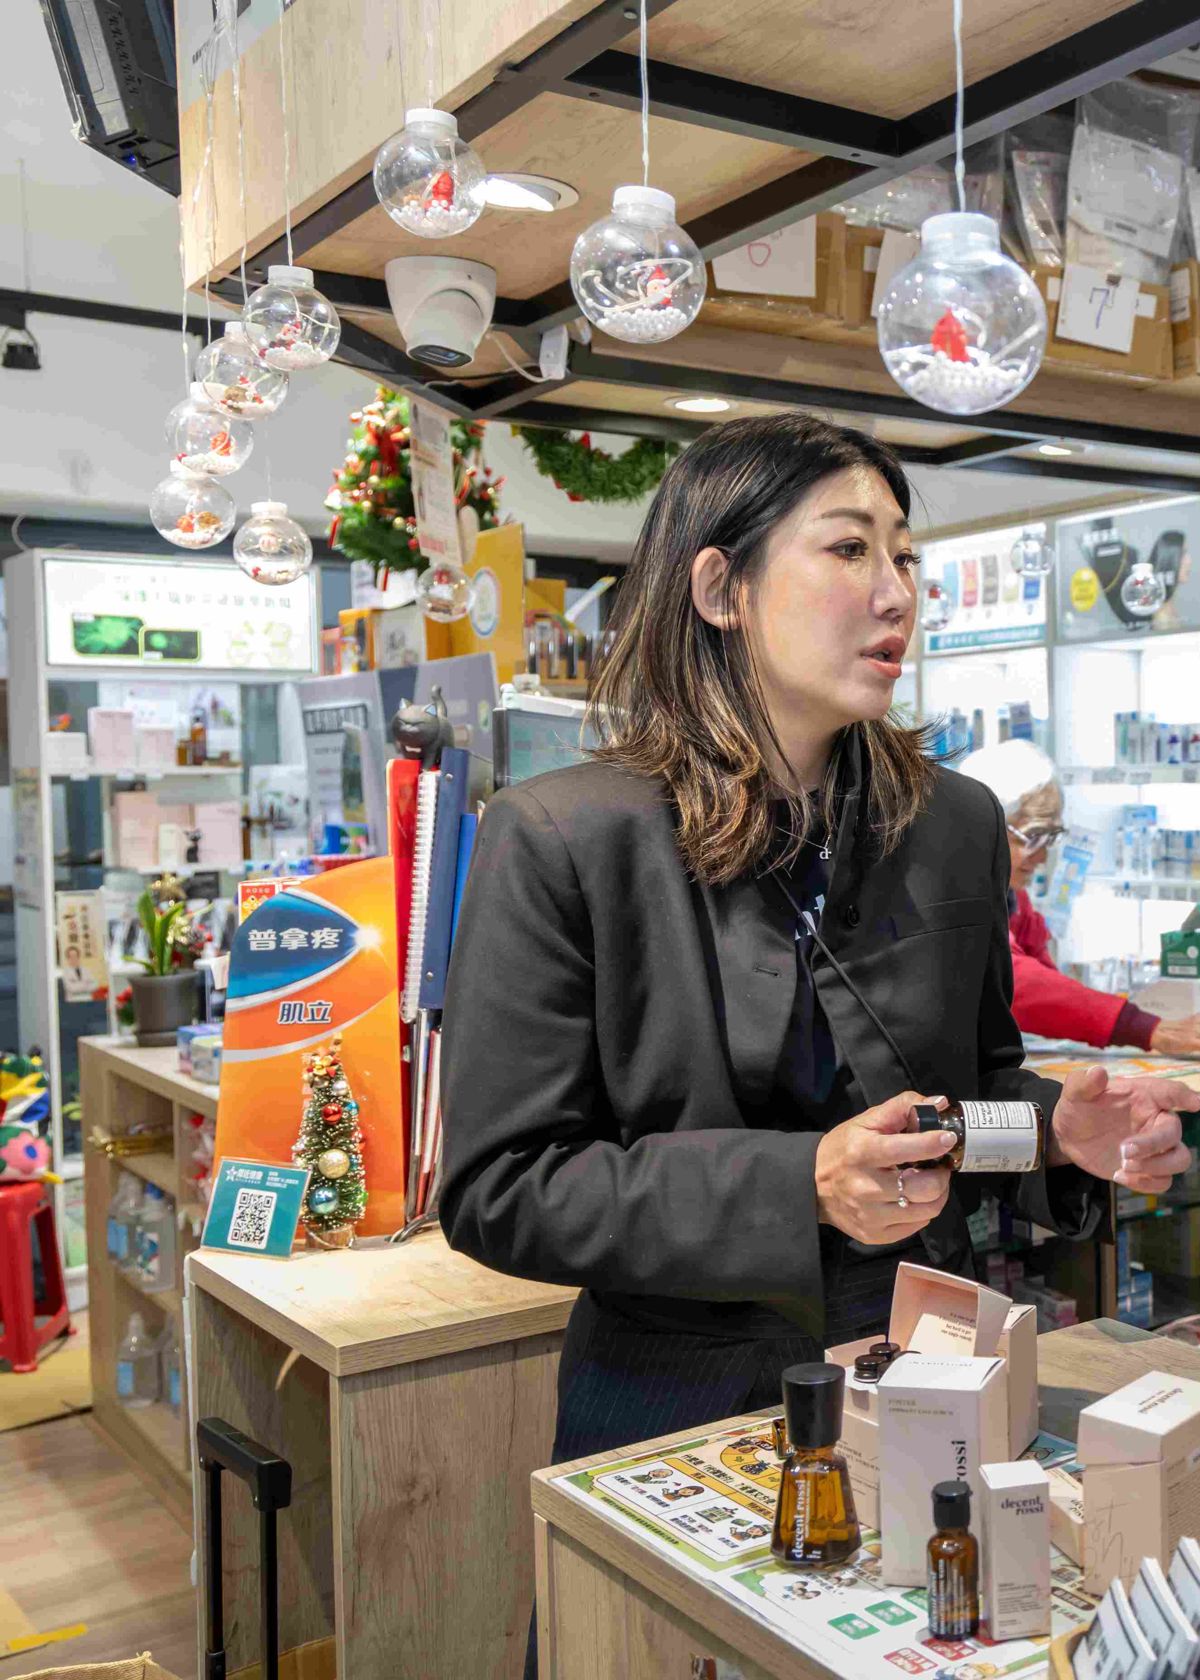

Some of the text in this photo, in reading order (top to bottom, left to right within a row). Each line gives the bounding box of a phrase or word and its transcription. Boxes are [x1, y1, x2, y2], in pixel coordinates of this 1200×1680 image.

[1088, 286, 1110, 330] 7
[248, 927, 344, 951] 普拿疼
[277, 1000, 333, 1025] 肌立
[1000, 1495, 1041, 1510] decent
[1015, 1504, 1044, 1516] rossi
[791, 1479, 806, 1558] decent rossi
